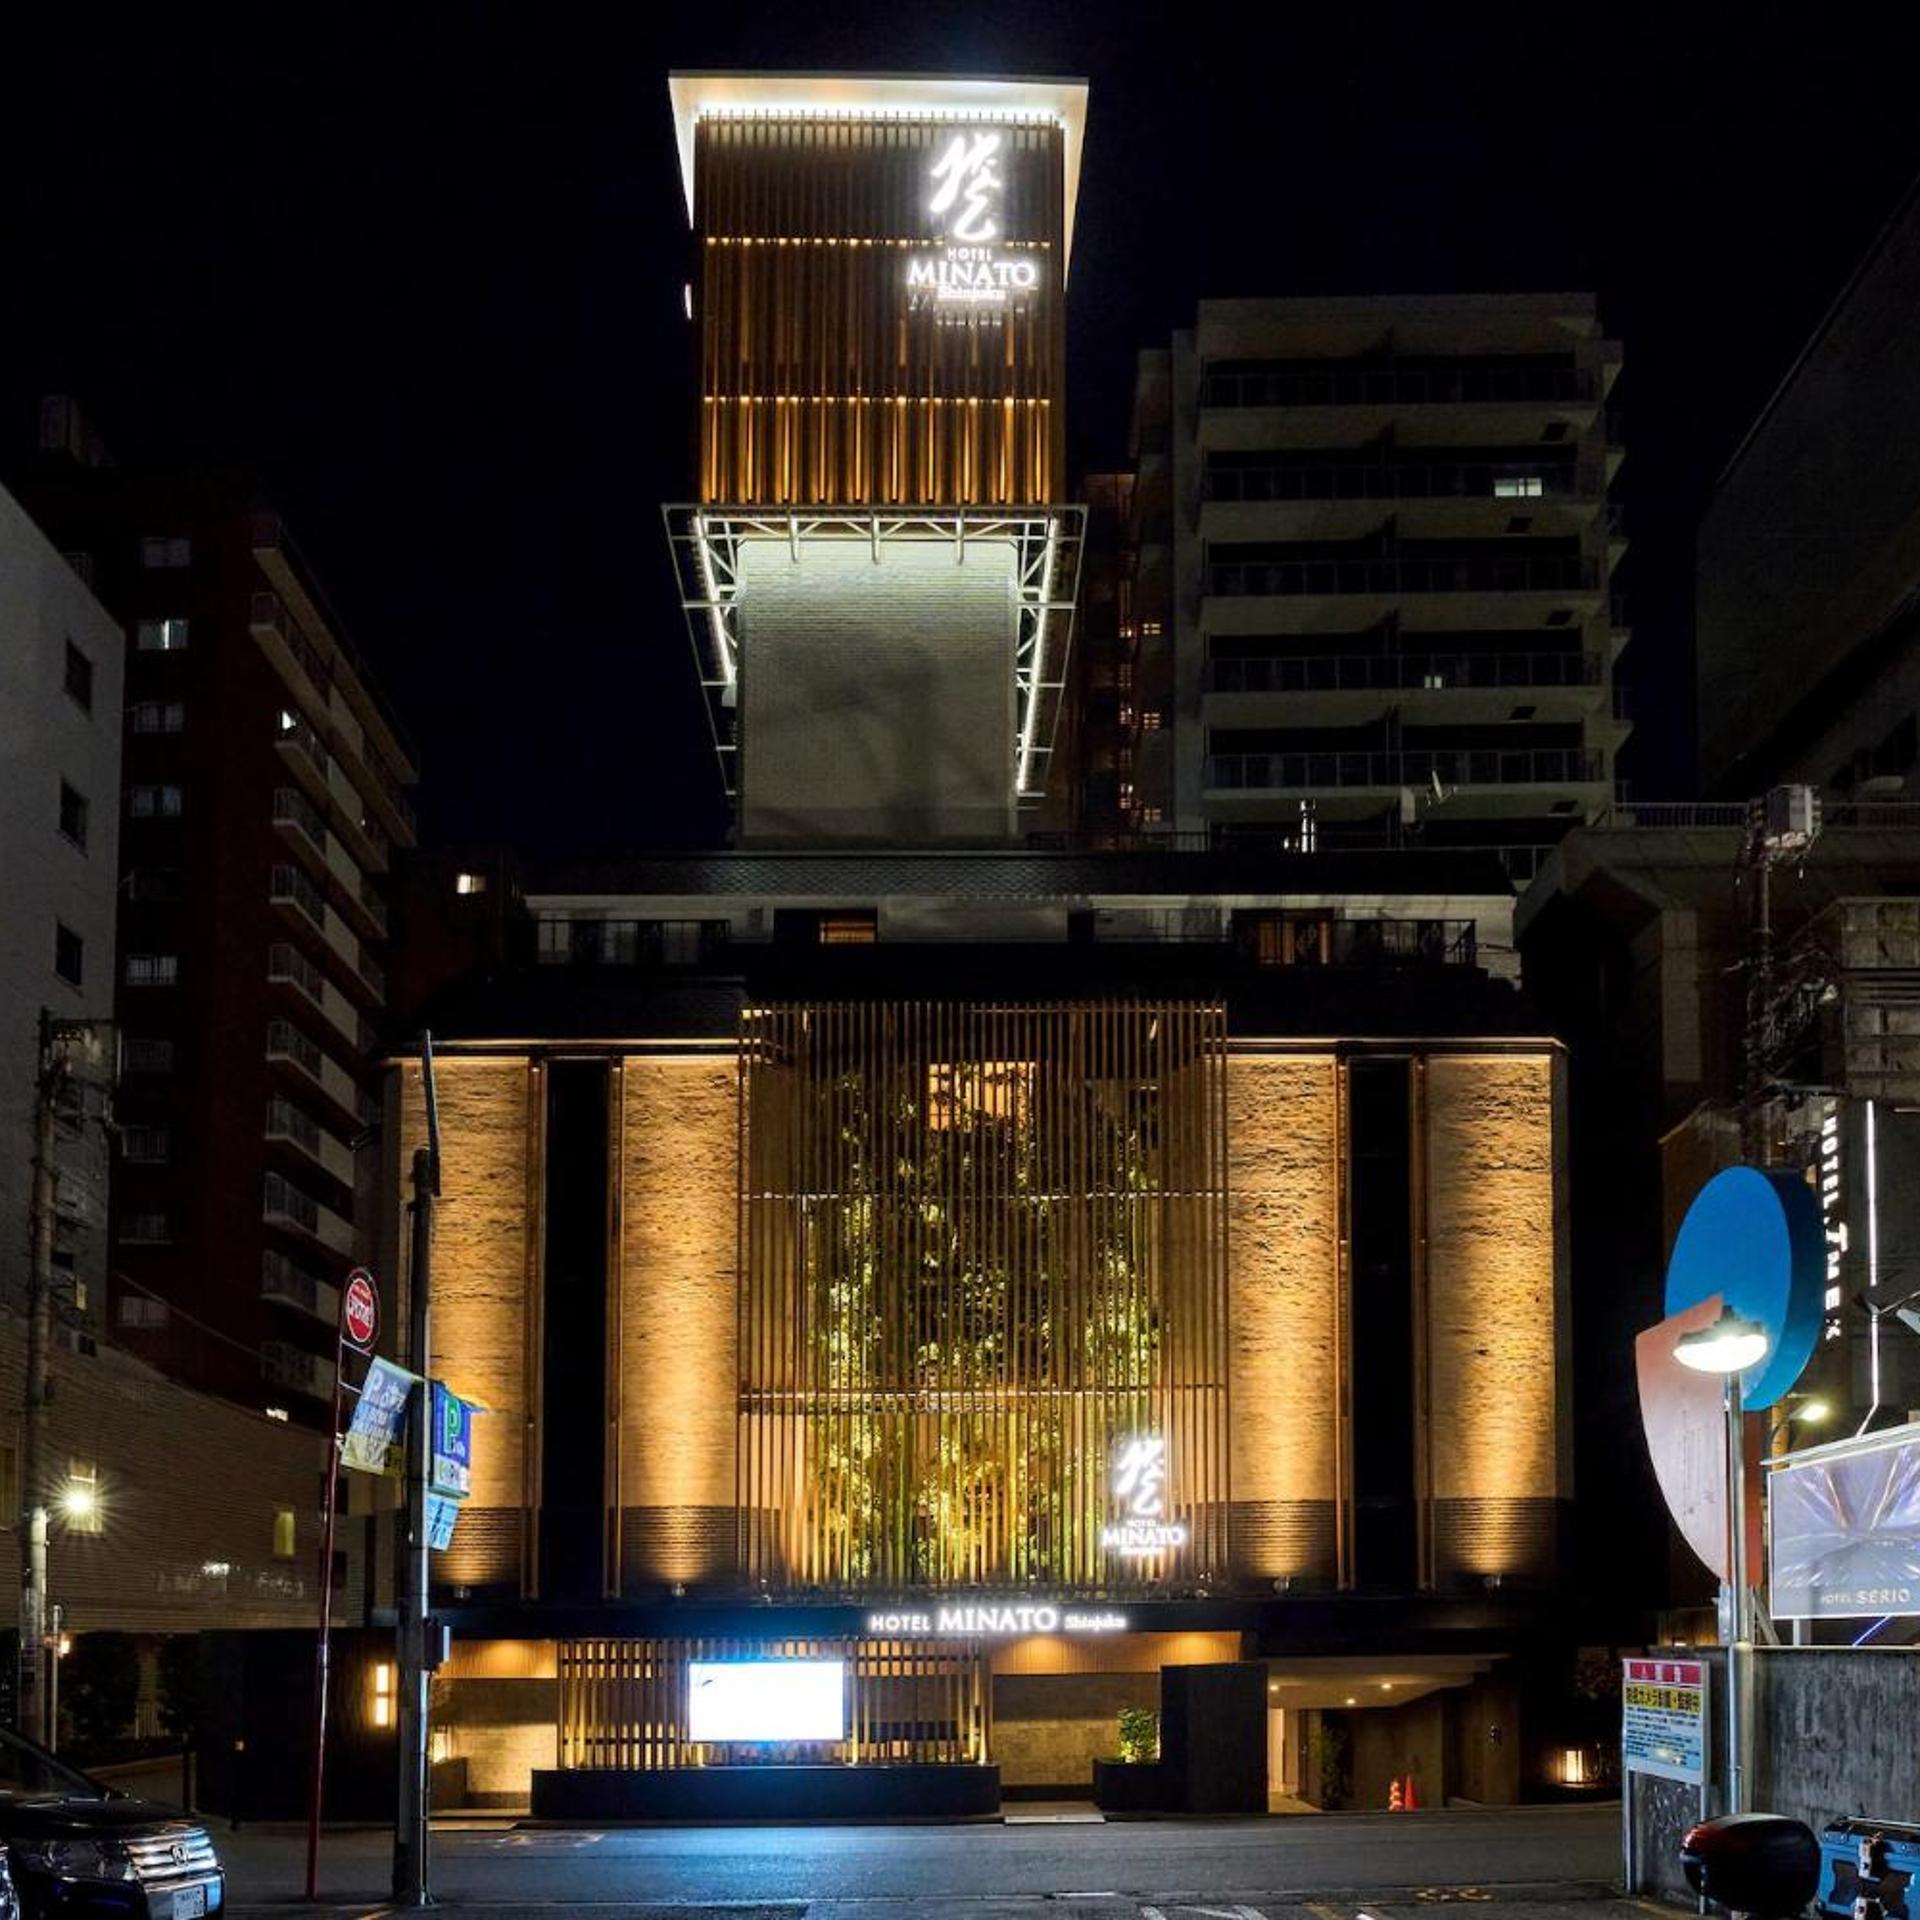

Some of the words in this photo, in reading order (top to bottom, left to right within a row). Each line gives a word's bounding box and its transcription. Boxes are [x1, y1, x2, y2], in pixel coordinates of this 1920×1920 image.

[947, 248, 992, 261] HOTEL
[908, 259, 1037, 286] MINATO
[1821, 1115, 1838, 1209] HOTEL
[1101, 1526, 1187, 1547] MINATO
[1856, 1587, 1911, 1605] SERIO
[870, 1614, 930, 1631] HOTEL
[938, 1607, 1058, 1632] MINATO
[1064, 1614, 1126, 1631] Shinjuku
